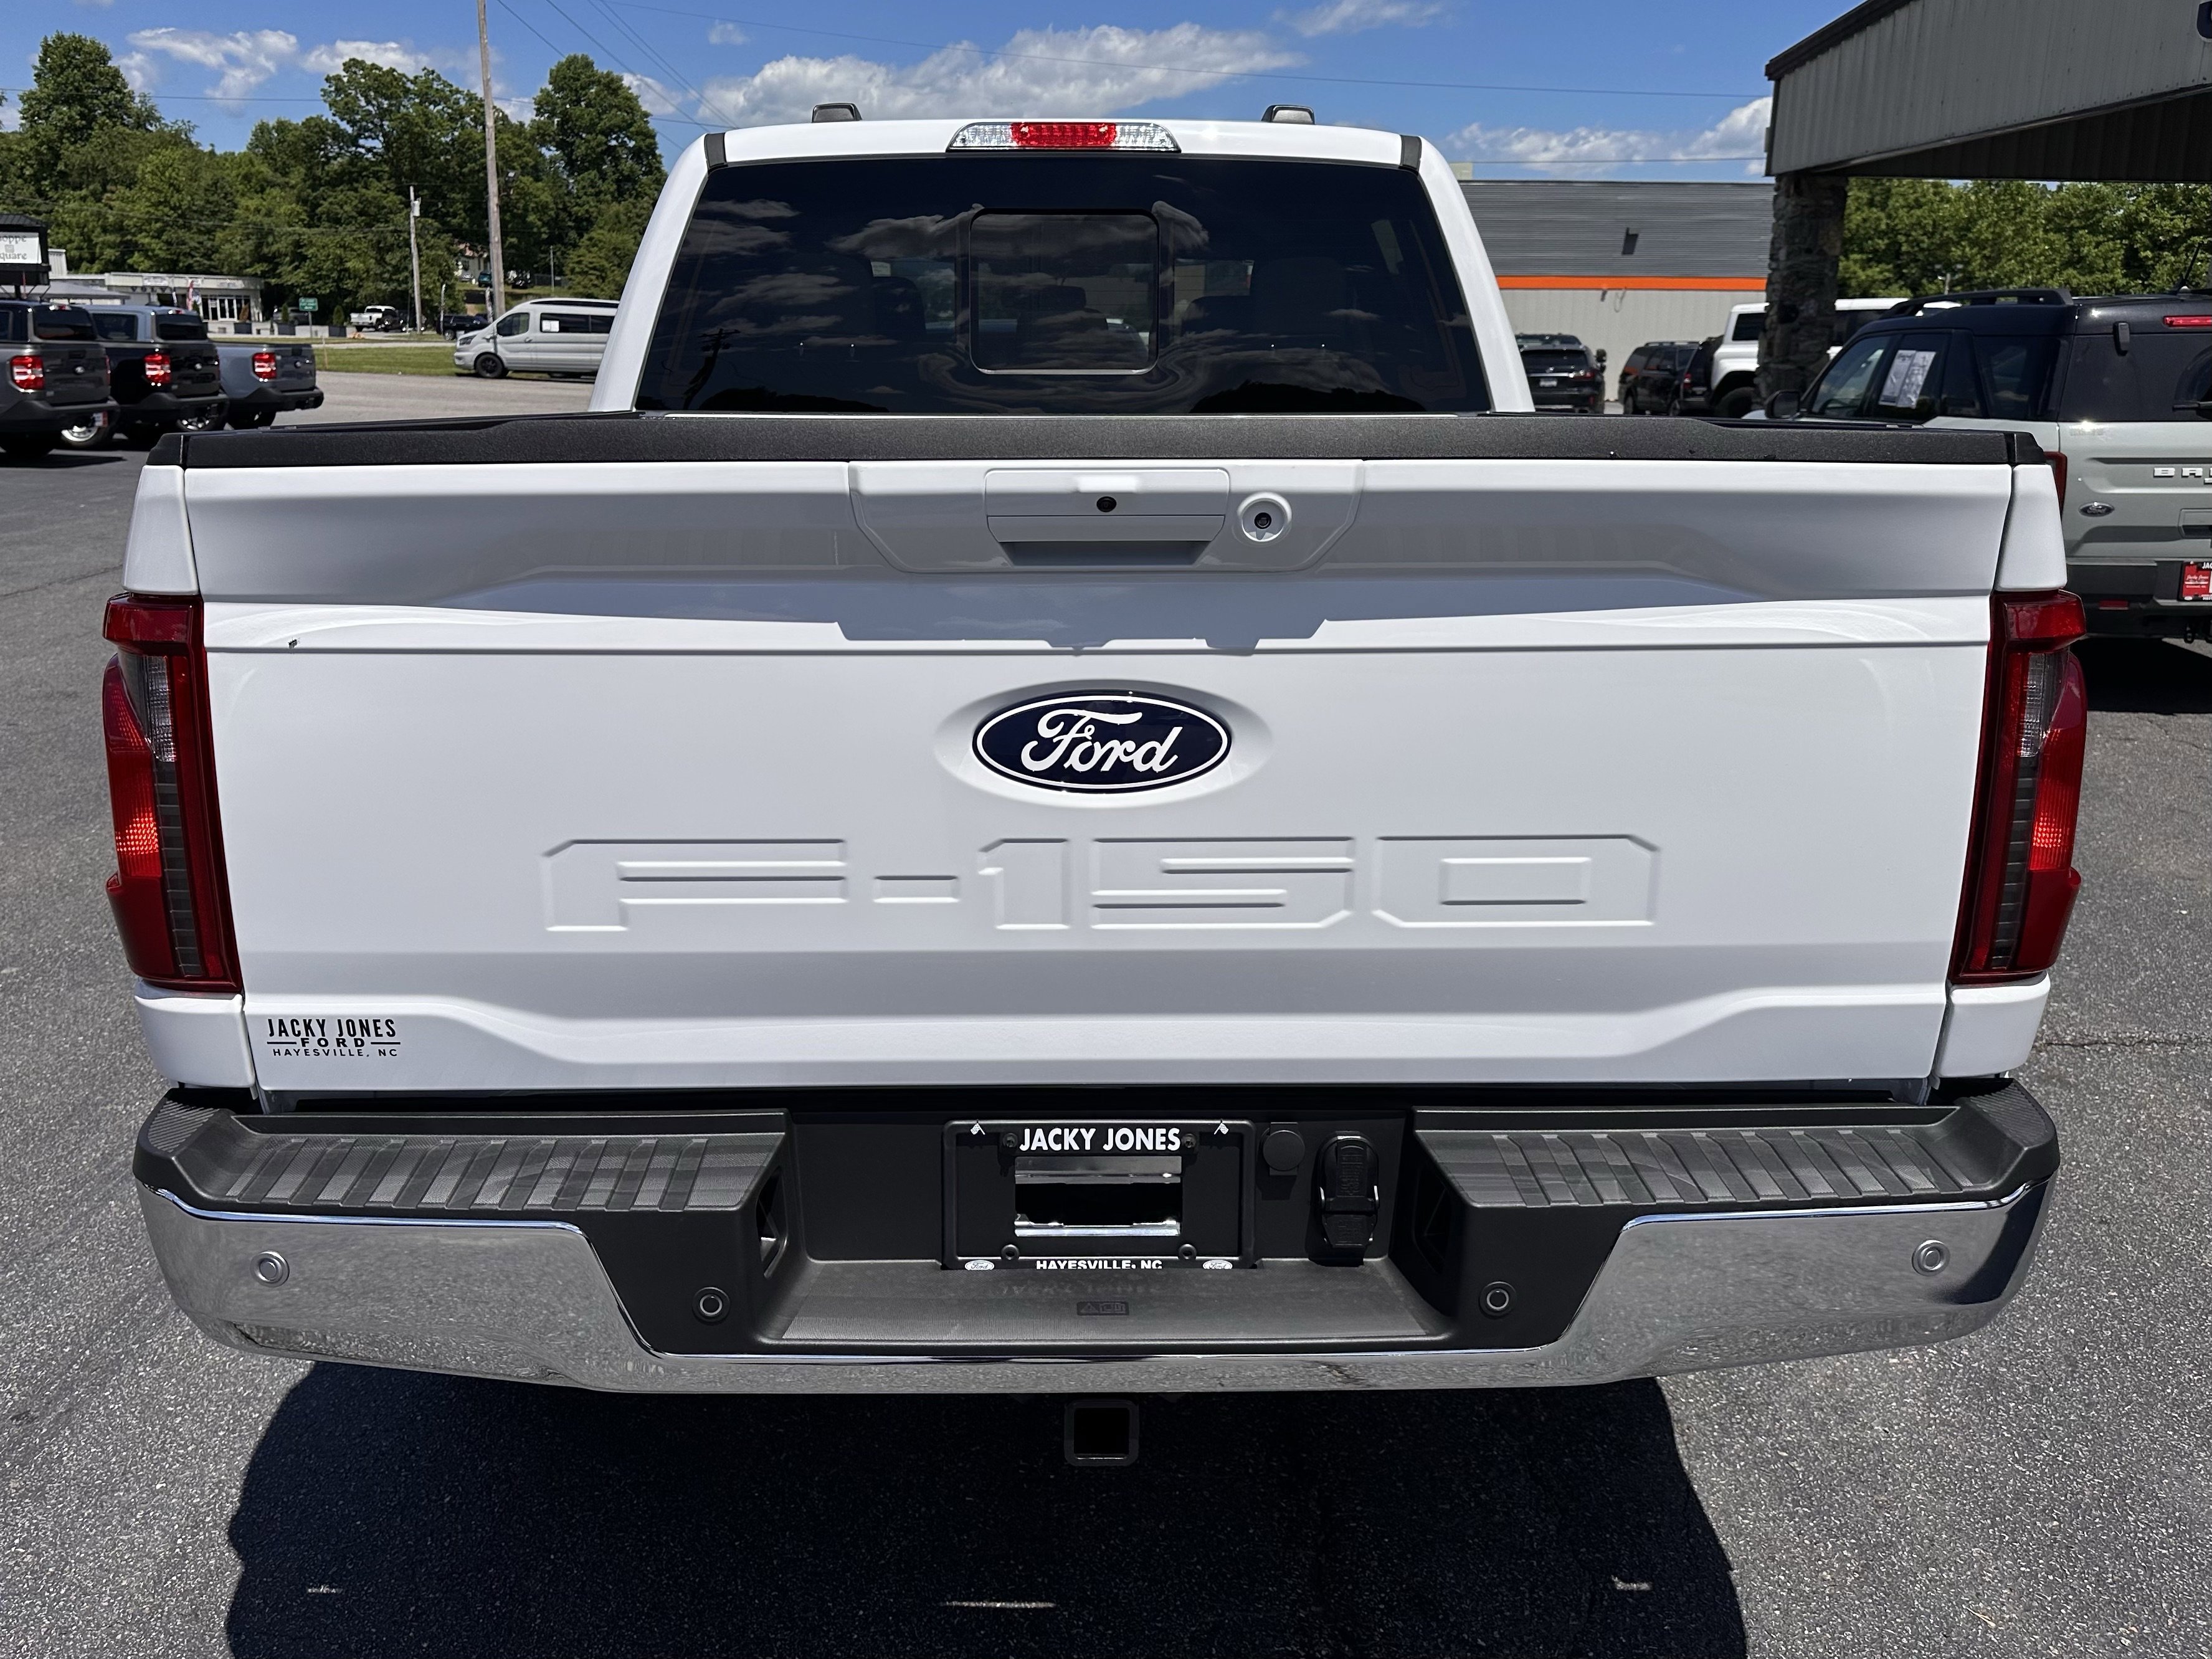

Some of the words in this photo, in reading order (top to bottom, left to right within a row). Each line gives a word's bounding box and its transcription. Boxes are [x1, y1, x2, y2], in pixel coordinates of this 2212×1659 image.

[2153, 467, 2212, 477] BR
[1021, 709, 1183, 772] Ford
[540, 836, 1659, 931] F-150
[267, 1019, 326, 1037] JACKY
[338, 1019, 396, 1037] JONES
[301, 1038, 365, 1047] FORD
[273, 1048, 369, 1057] HAYESVILLE,
[379, 1048, 397, 1057] NC
[1019, 1128, 1096, 1151] JACKY
[1103, 1128, 1180, 1151] JONES
[1141, 1260, 1162, 1269] NC
